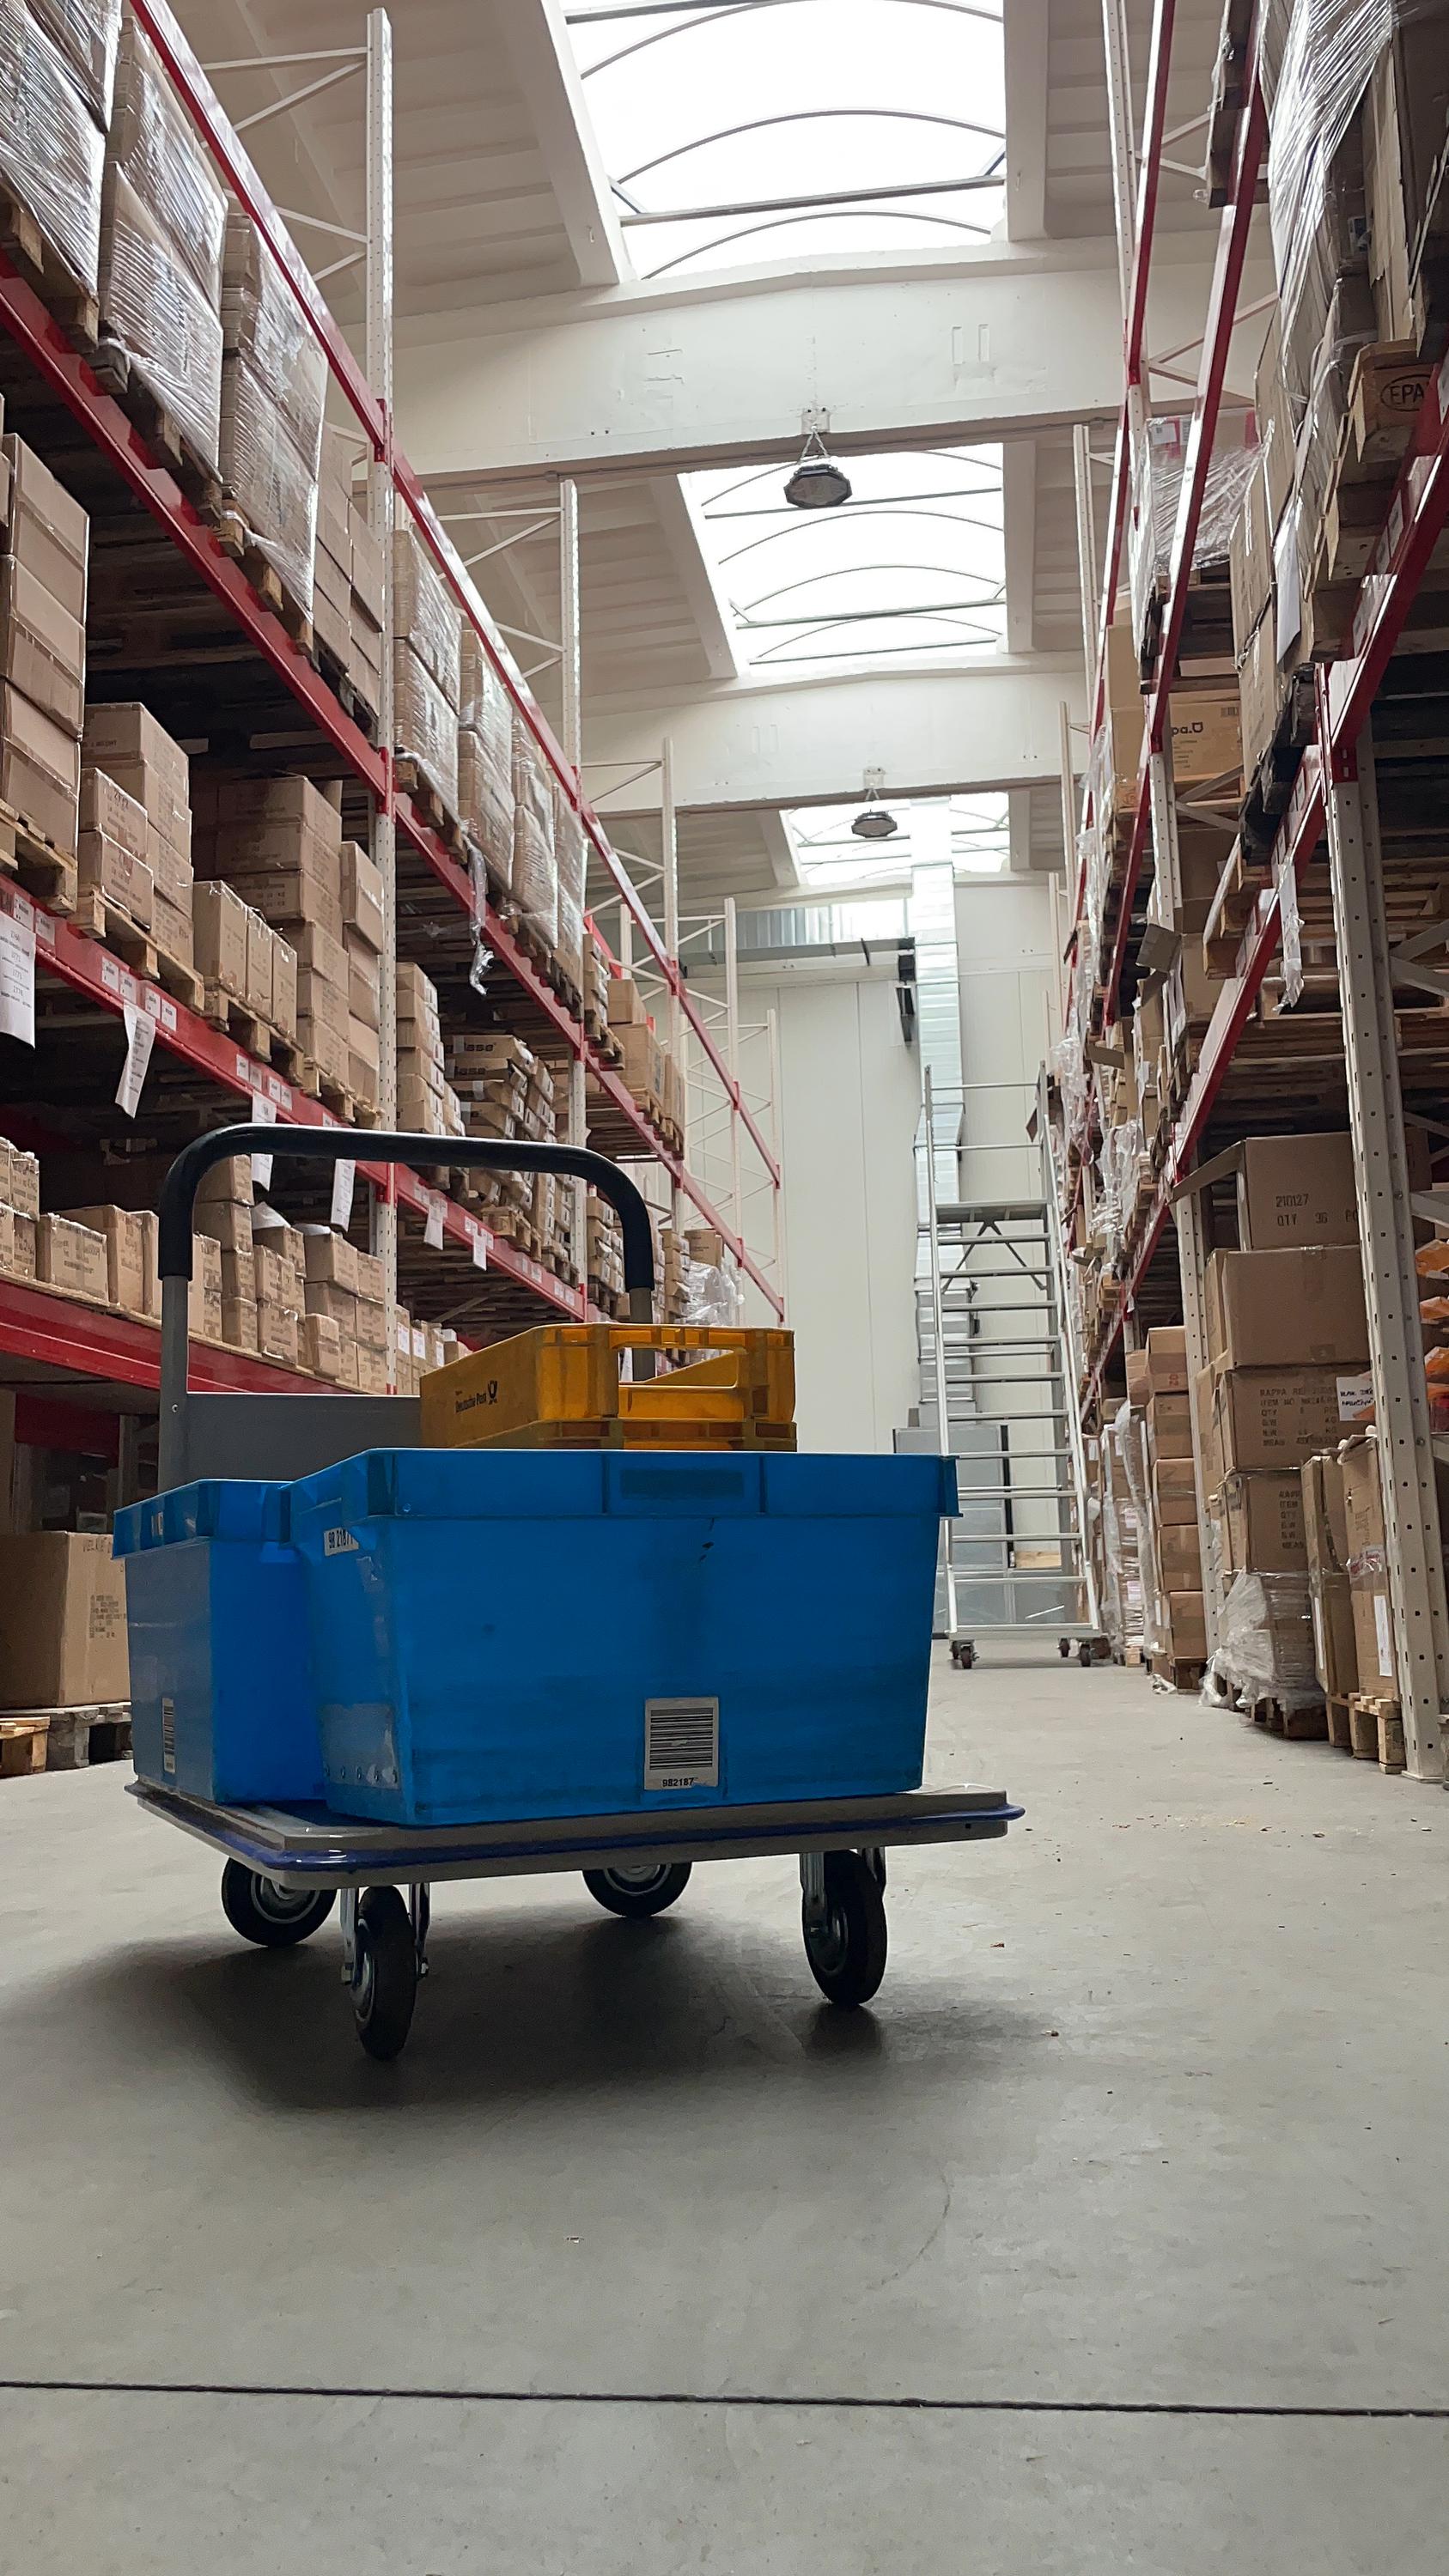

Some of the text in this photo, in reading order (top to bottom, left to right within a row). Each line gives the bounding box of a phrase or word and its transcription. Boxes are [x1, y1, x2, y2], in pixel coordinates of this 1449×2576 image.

[1390, 383, 1424, 404] EPA
[1275, 1194, 1309, 1208] 210127
[1277, 1213, 1297, 1226] QTY
[1345, 1209, 1358, 1223] PC
[1259, 1388, 1287, 1397] RAPPA
[477, 1392, 487, 1406] Post
[1260, 1397, 1279, 1406] ITEM
[1261, 1408, 1278, 1417] QTY
[1278, 1490, 1301, 1498] RAPP
[1280, 1500, 1299, 1509] ITEM
[662, 1777, 695, 1787] 982187
